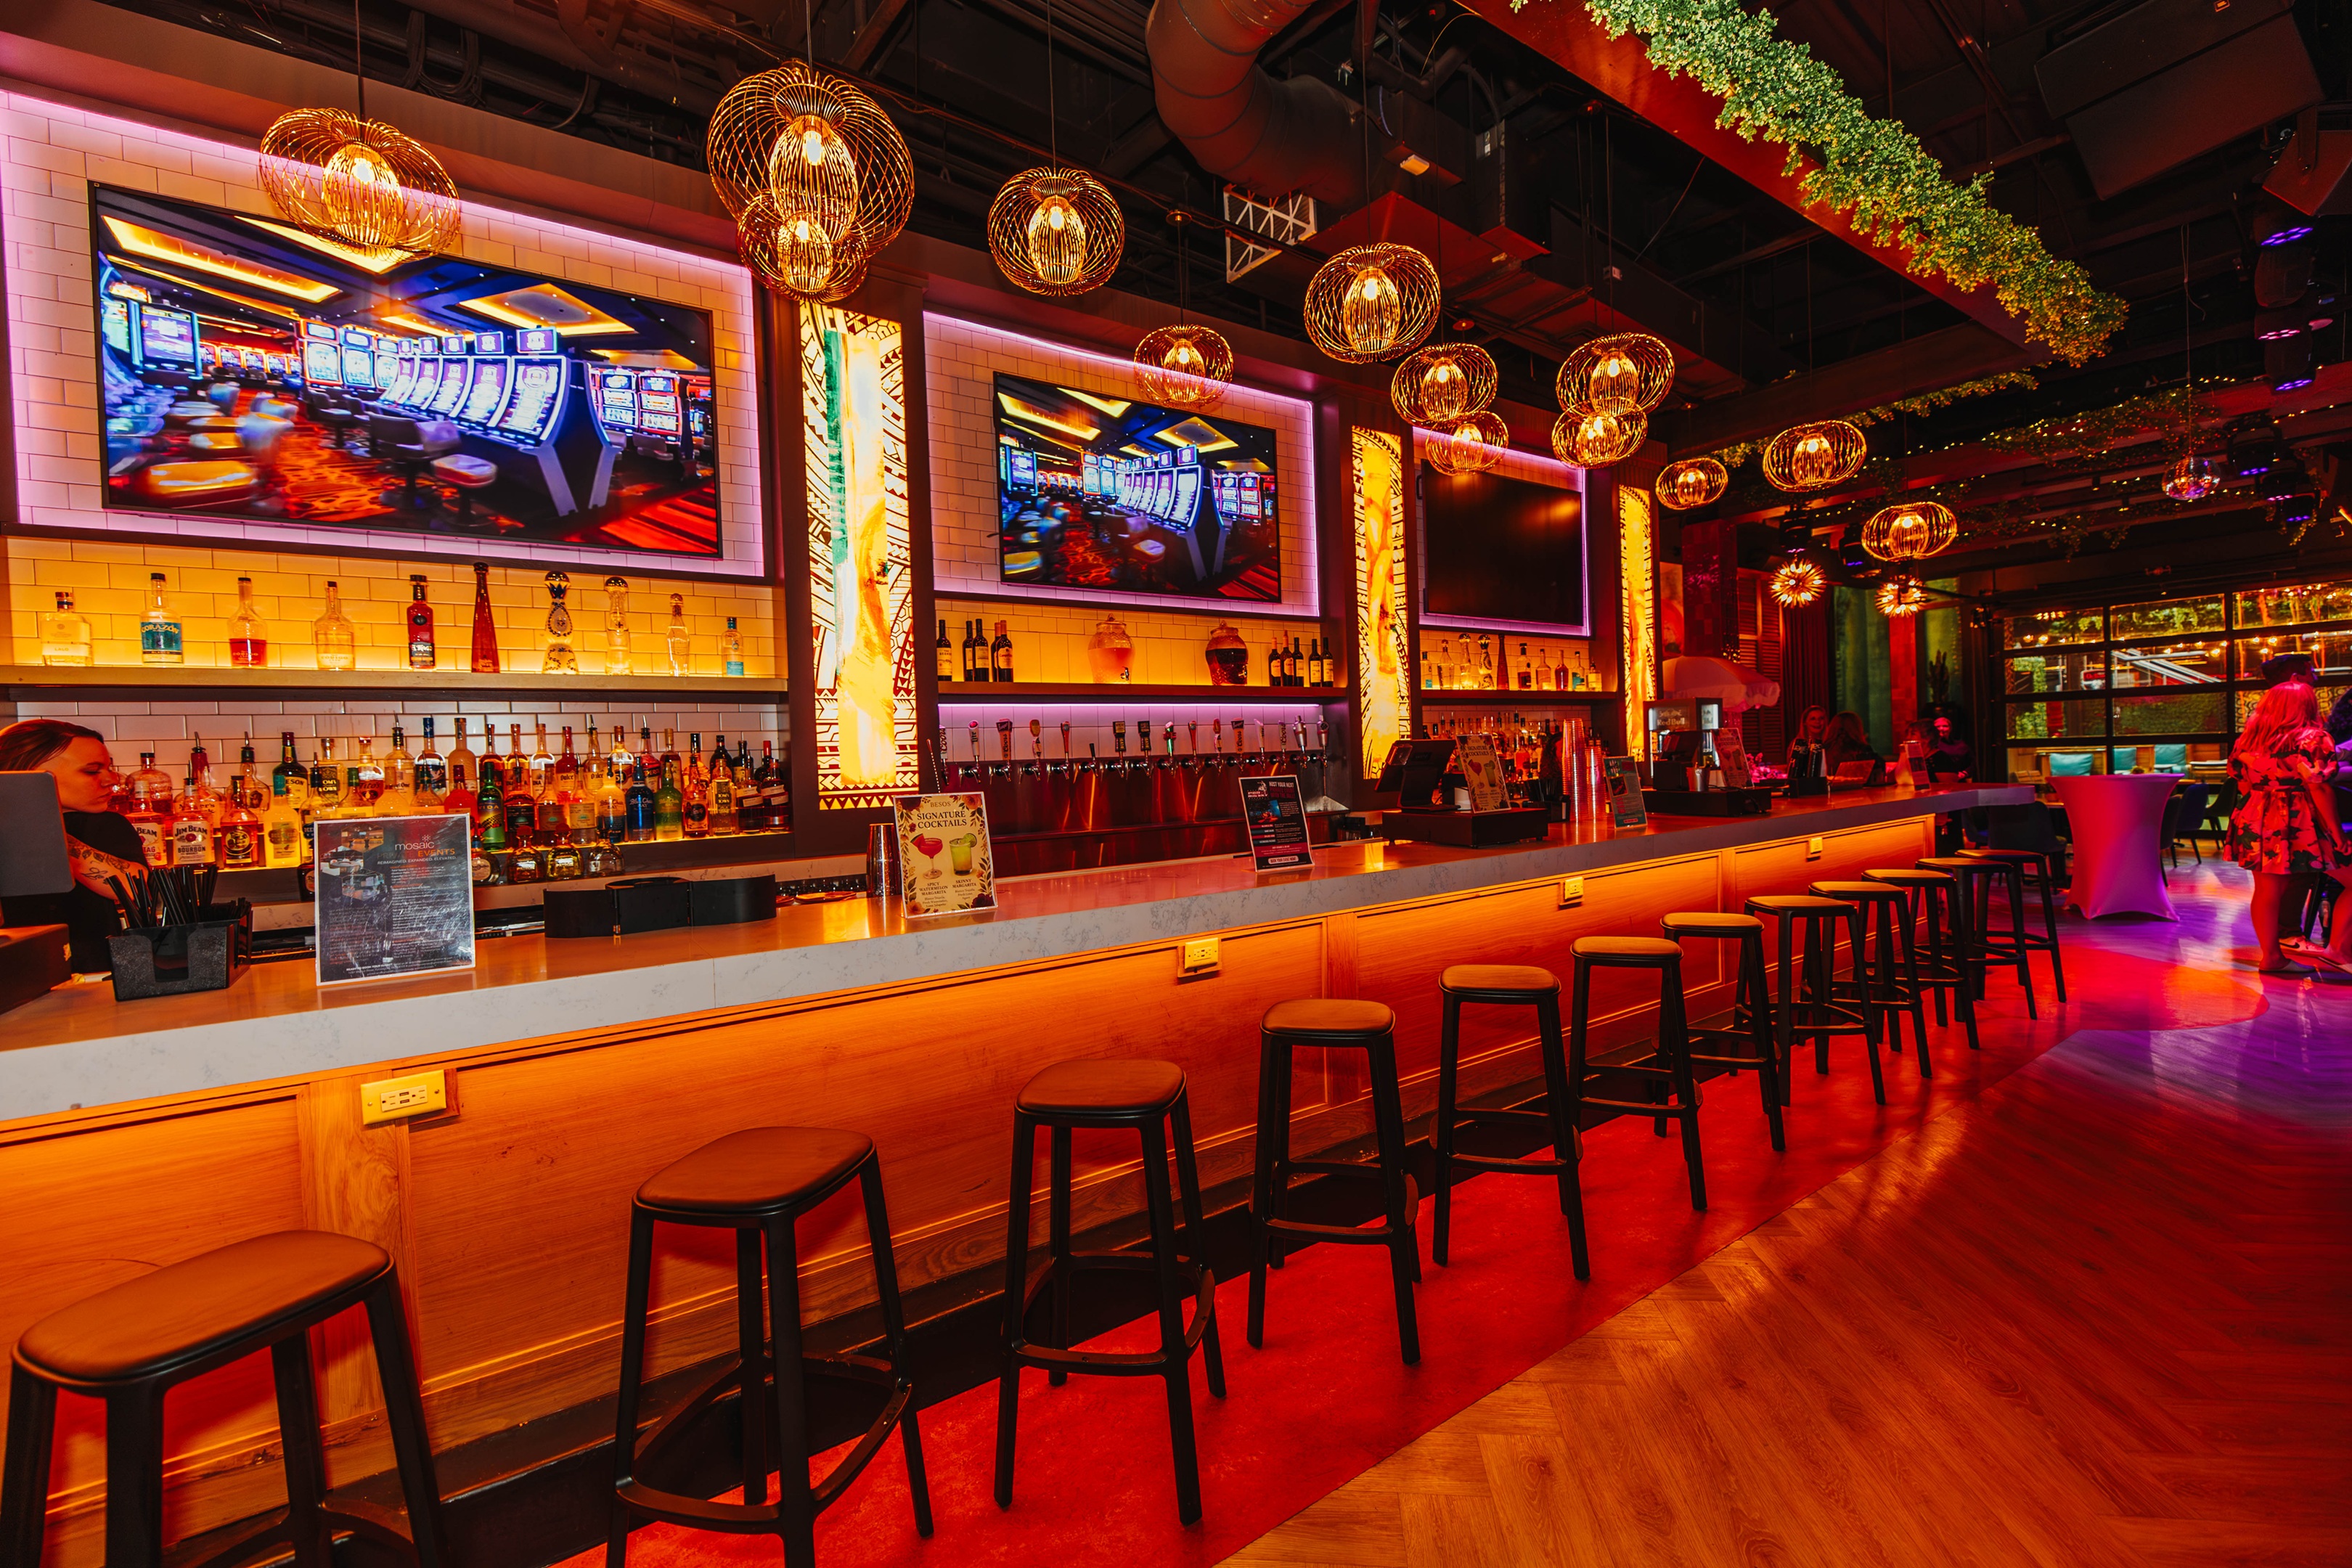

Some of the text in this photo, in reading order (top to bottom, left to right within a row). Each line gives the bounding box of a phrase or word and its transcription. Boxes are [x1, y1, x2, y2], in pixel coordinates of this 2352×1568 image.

[917, 811, 965, 820] SIGNATURE
[918, 819, 967, 828] COCKTAILS
[175, 825, 208, 836] JIM BEAM
